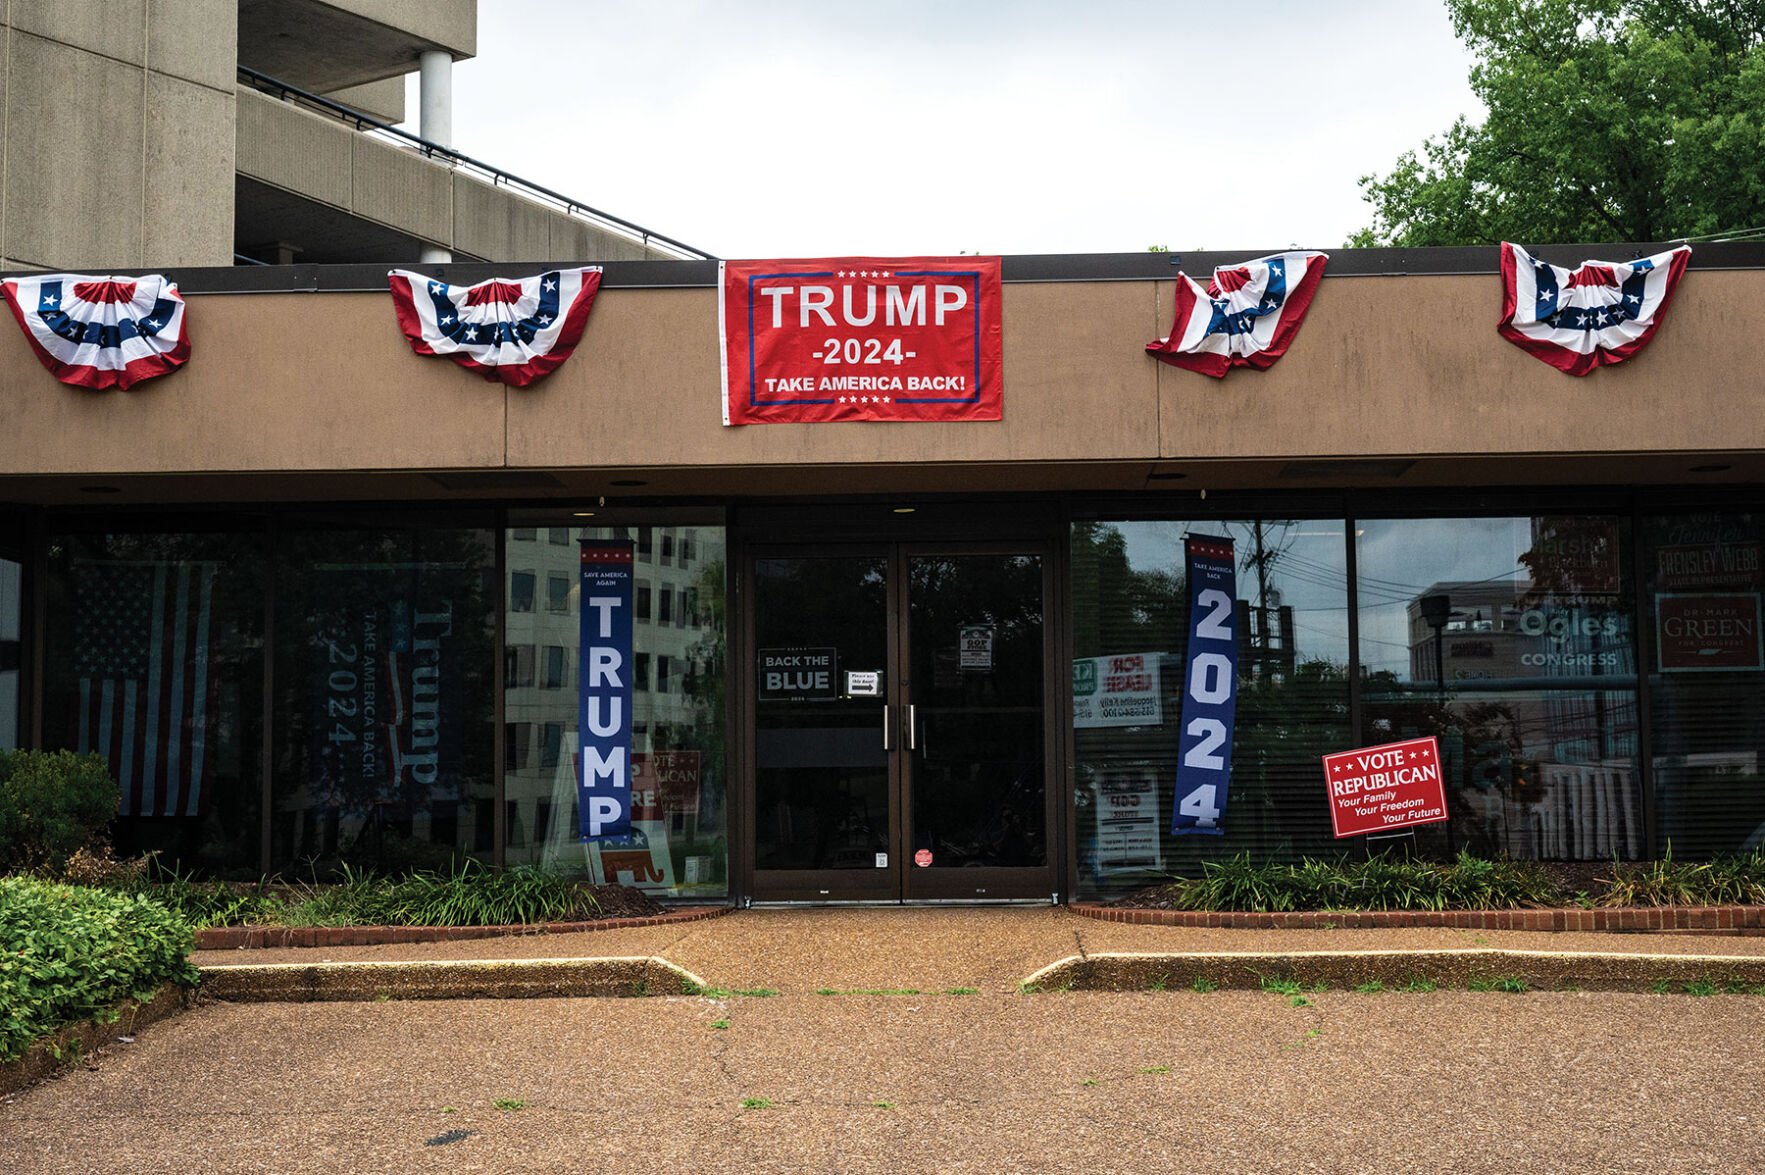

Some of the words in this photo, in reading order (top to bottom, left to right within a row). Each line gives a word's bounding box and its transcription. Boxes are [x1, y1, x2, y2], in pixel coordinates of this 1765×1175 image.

[761, 285, 968, 328] TRUMP
[812, 338, 916, 365] -2024-
[765, 378, 815, 392] TAKE
[819, 376, 901, 391] AMERICA
[908, 375, 965, 391] BACK!
[1720, 546, 1760, 572] WEBB
[362, 611, 378, 652] TAKE
[1520, 608, 1617, 643] Ogles
[1664, 616, 1752, 639] GREEN
[765, 656, 801, 667] BACK
[803, 656, 830, 666] THE
[1521, 653, 1617, 666] CONGRESS
[362, 655, 378, 727] AMERICA
[400, 599, 453, 784] Trump
[766, 671, 830, 691] BLUE
[328, 643, 358, 746] 2024
[1179, 588, 1233, 827] 2024
[583, 597, 626, 836] TRUMP
[1356, 749, 1405, 772] VOTE
[1333, 764, 1437, 797] REPUBLICAN
[1338, 797, 1361, 808] Your
[1363, 791, 1397, 804] Family
[1354, 805, 1379, 817] Your
[1380, 798, 1425, 813] Freedom
[1382, 812, 1406, 823] Your
[1407, 807, 1442, 820] Future
